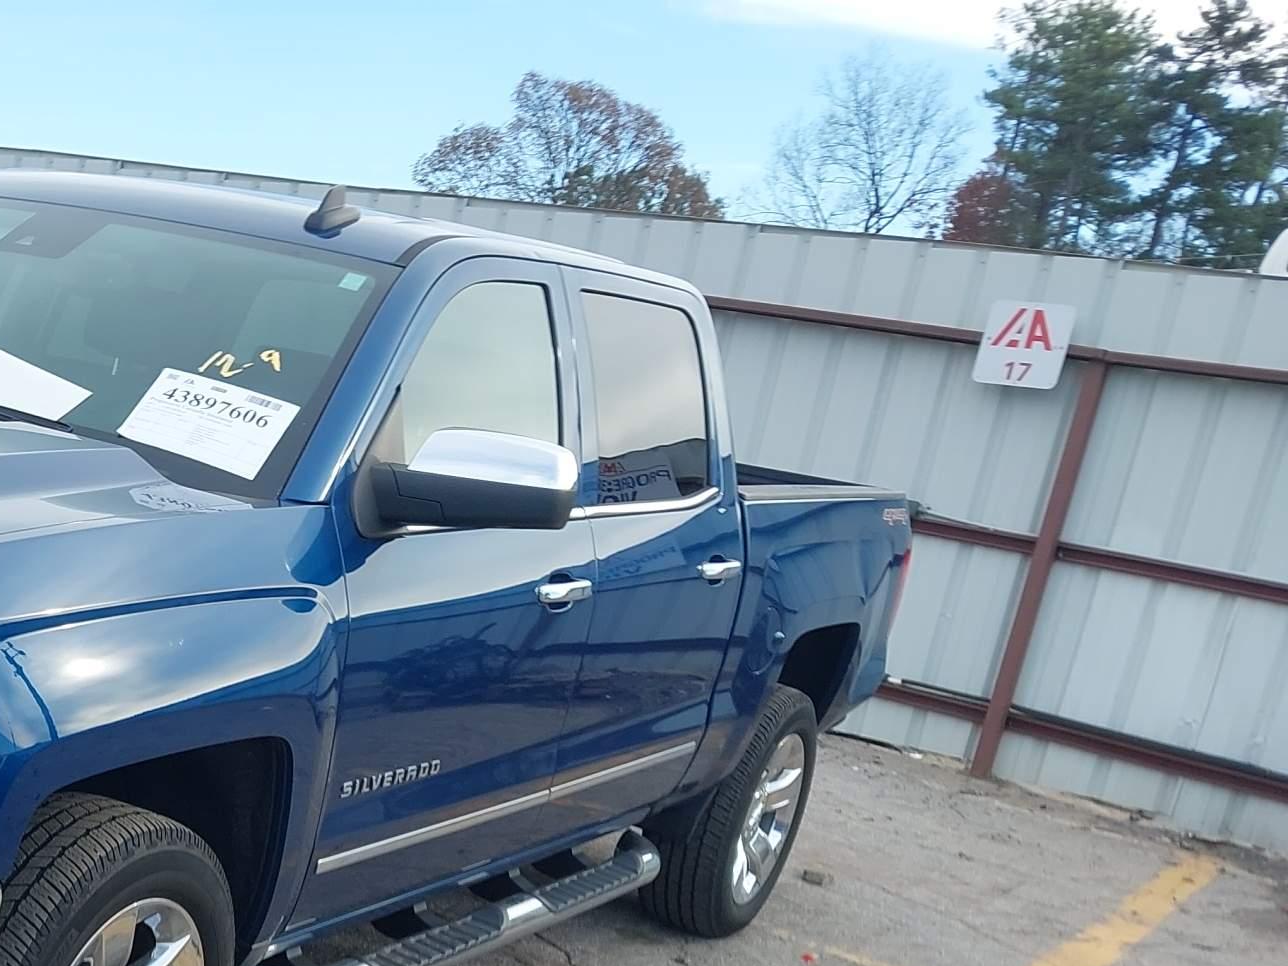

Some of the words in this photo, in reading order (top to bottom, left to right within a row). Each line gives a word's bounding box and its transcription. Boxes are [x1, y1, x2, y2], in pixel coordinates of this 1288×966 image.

[1004, 361, 1033, 381] 17
[162, 387, 273, 428] 43897606
[340, 759, 441, 798] SILVERADO
